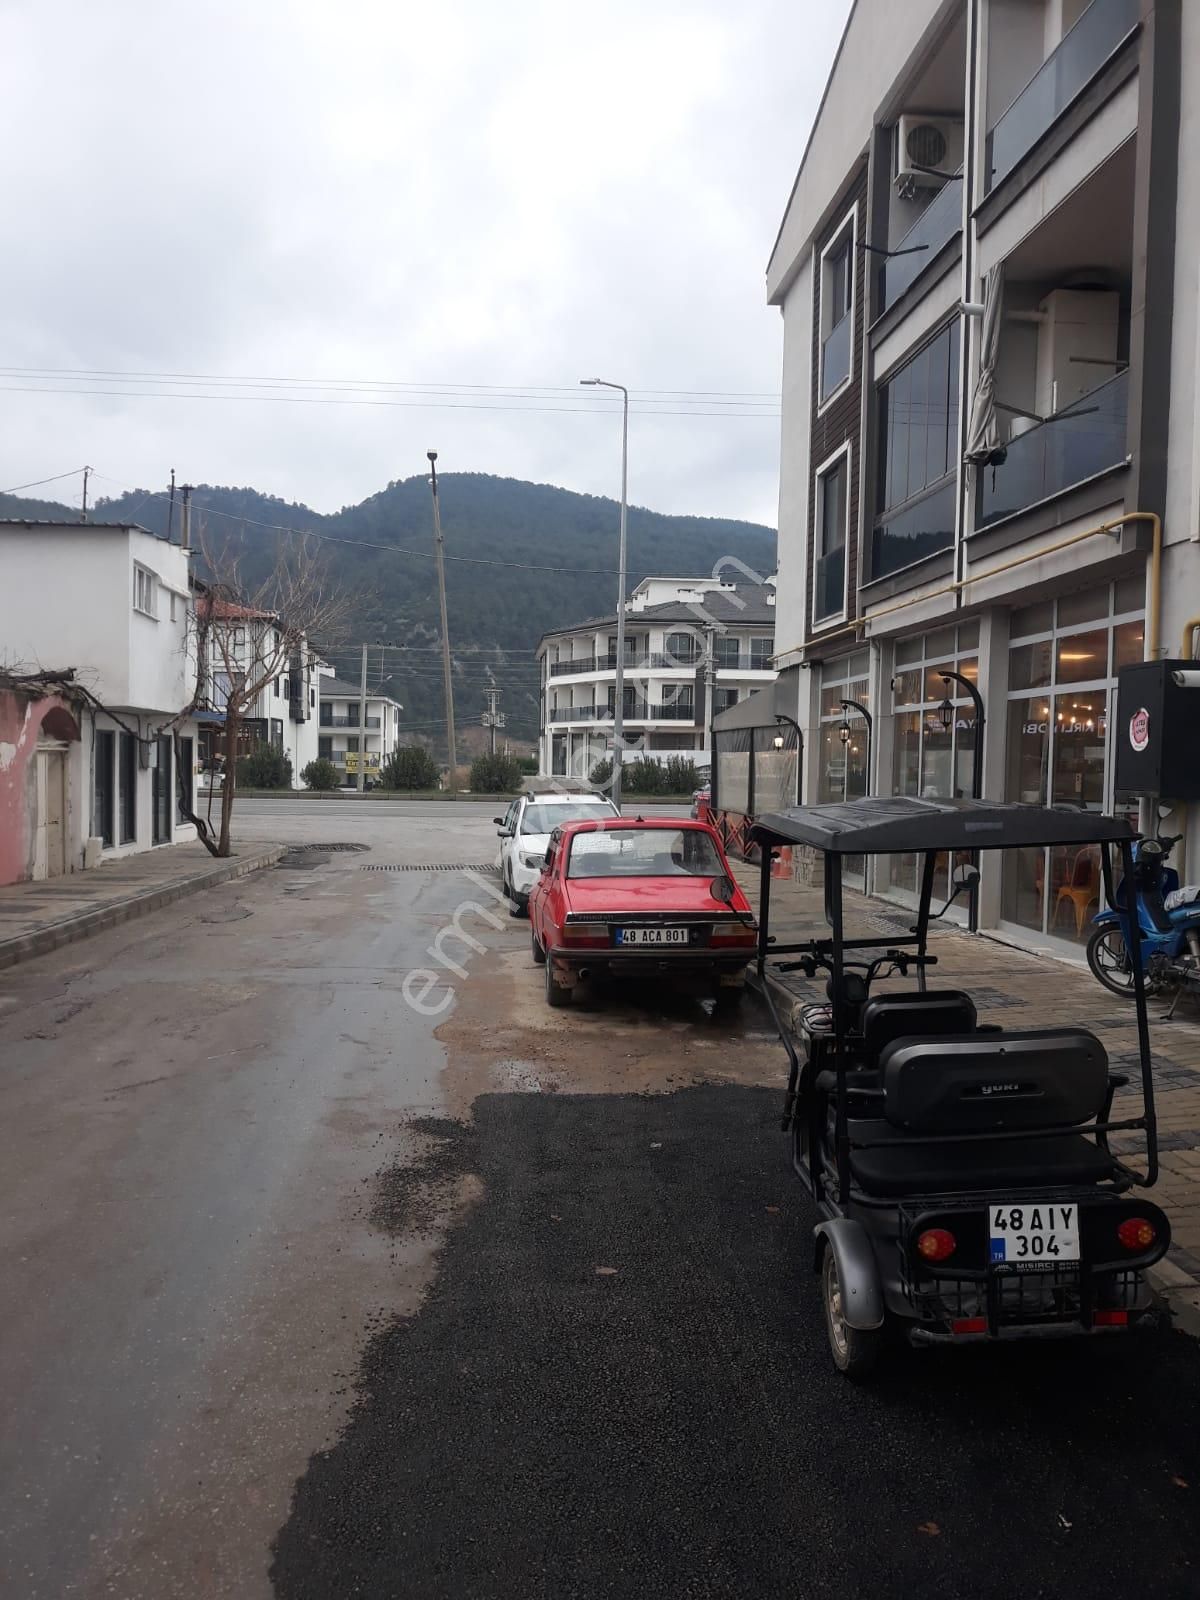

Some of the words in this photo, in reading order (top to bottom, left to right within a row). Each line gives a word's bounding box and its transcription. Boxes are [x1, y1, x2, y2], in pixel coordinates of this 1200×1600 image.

[623, 930, 636, 942] 48
[642, 930, 662, 942] ACA
[665, 930, 685, 942] 801
[994, 1208, 1024, 1231] 48
[1030, 1207, 1073, 1230] AIY
[1016, 1235, 1060, 1257] 304
[993, 1252, 1005, 1260] TR
